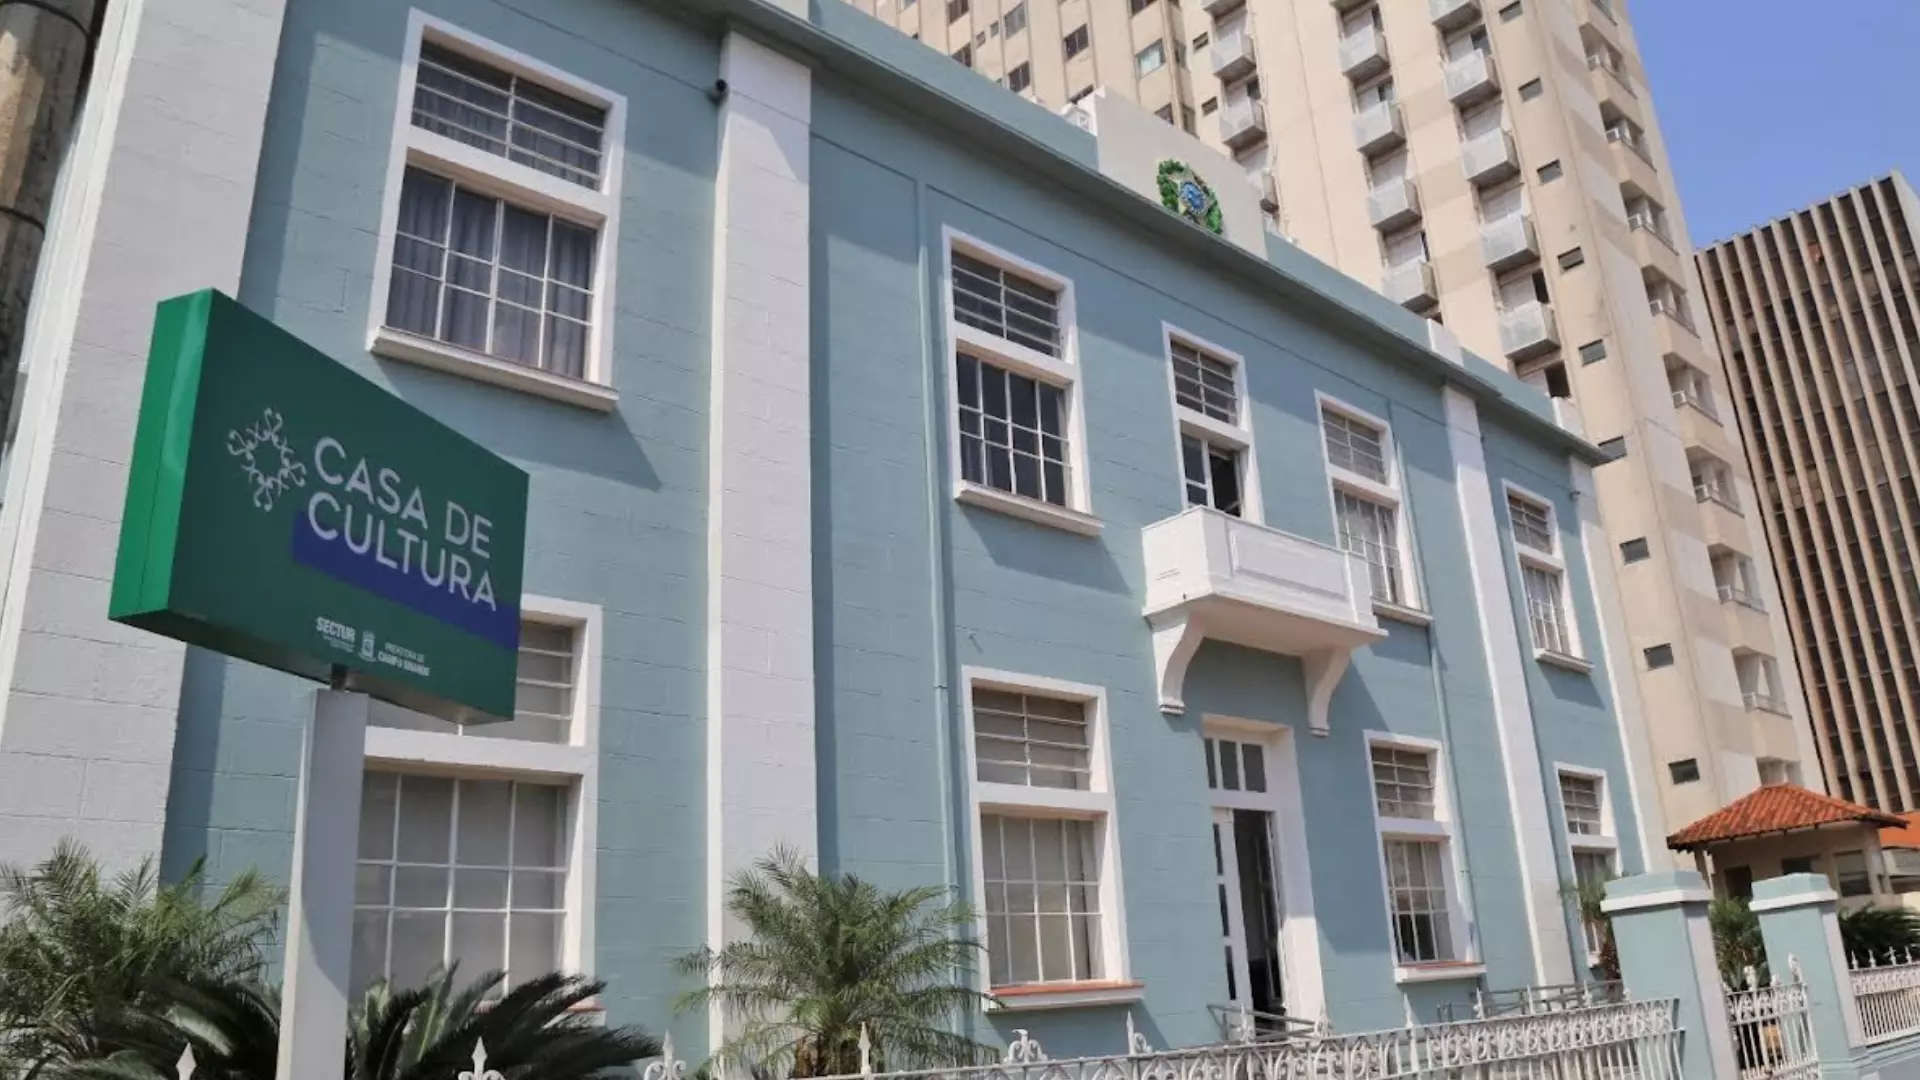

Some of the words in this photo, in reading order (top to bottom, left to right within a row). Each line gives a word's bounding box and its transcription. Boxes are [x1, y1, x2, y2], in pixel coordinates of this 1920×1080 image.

[309, 491, 496, 611] CULTURA
[314, 437, 428, 529] CASA
[445, 501, 493, 559] DE
[316, 617, 355, 643] SECTUR
